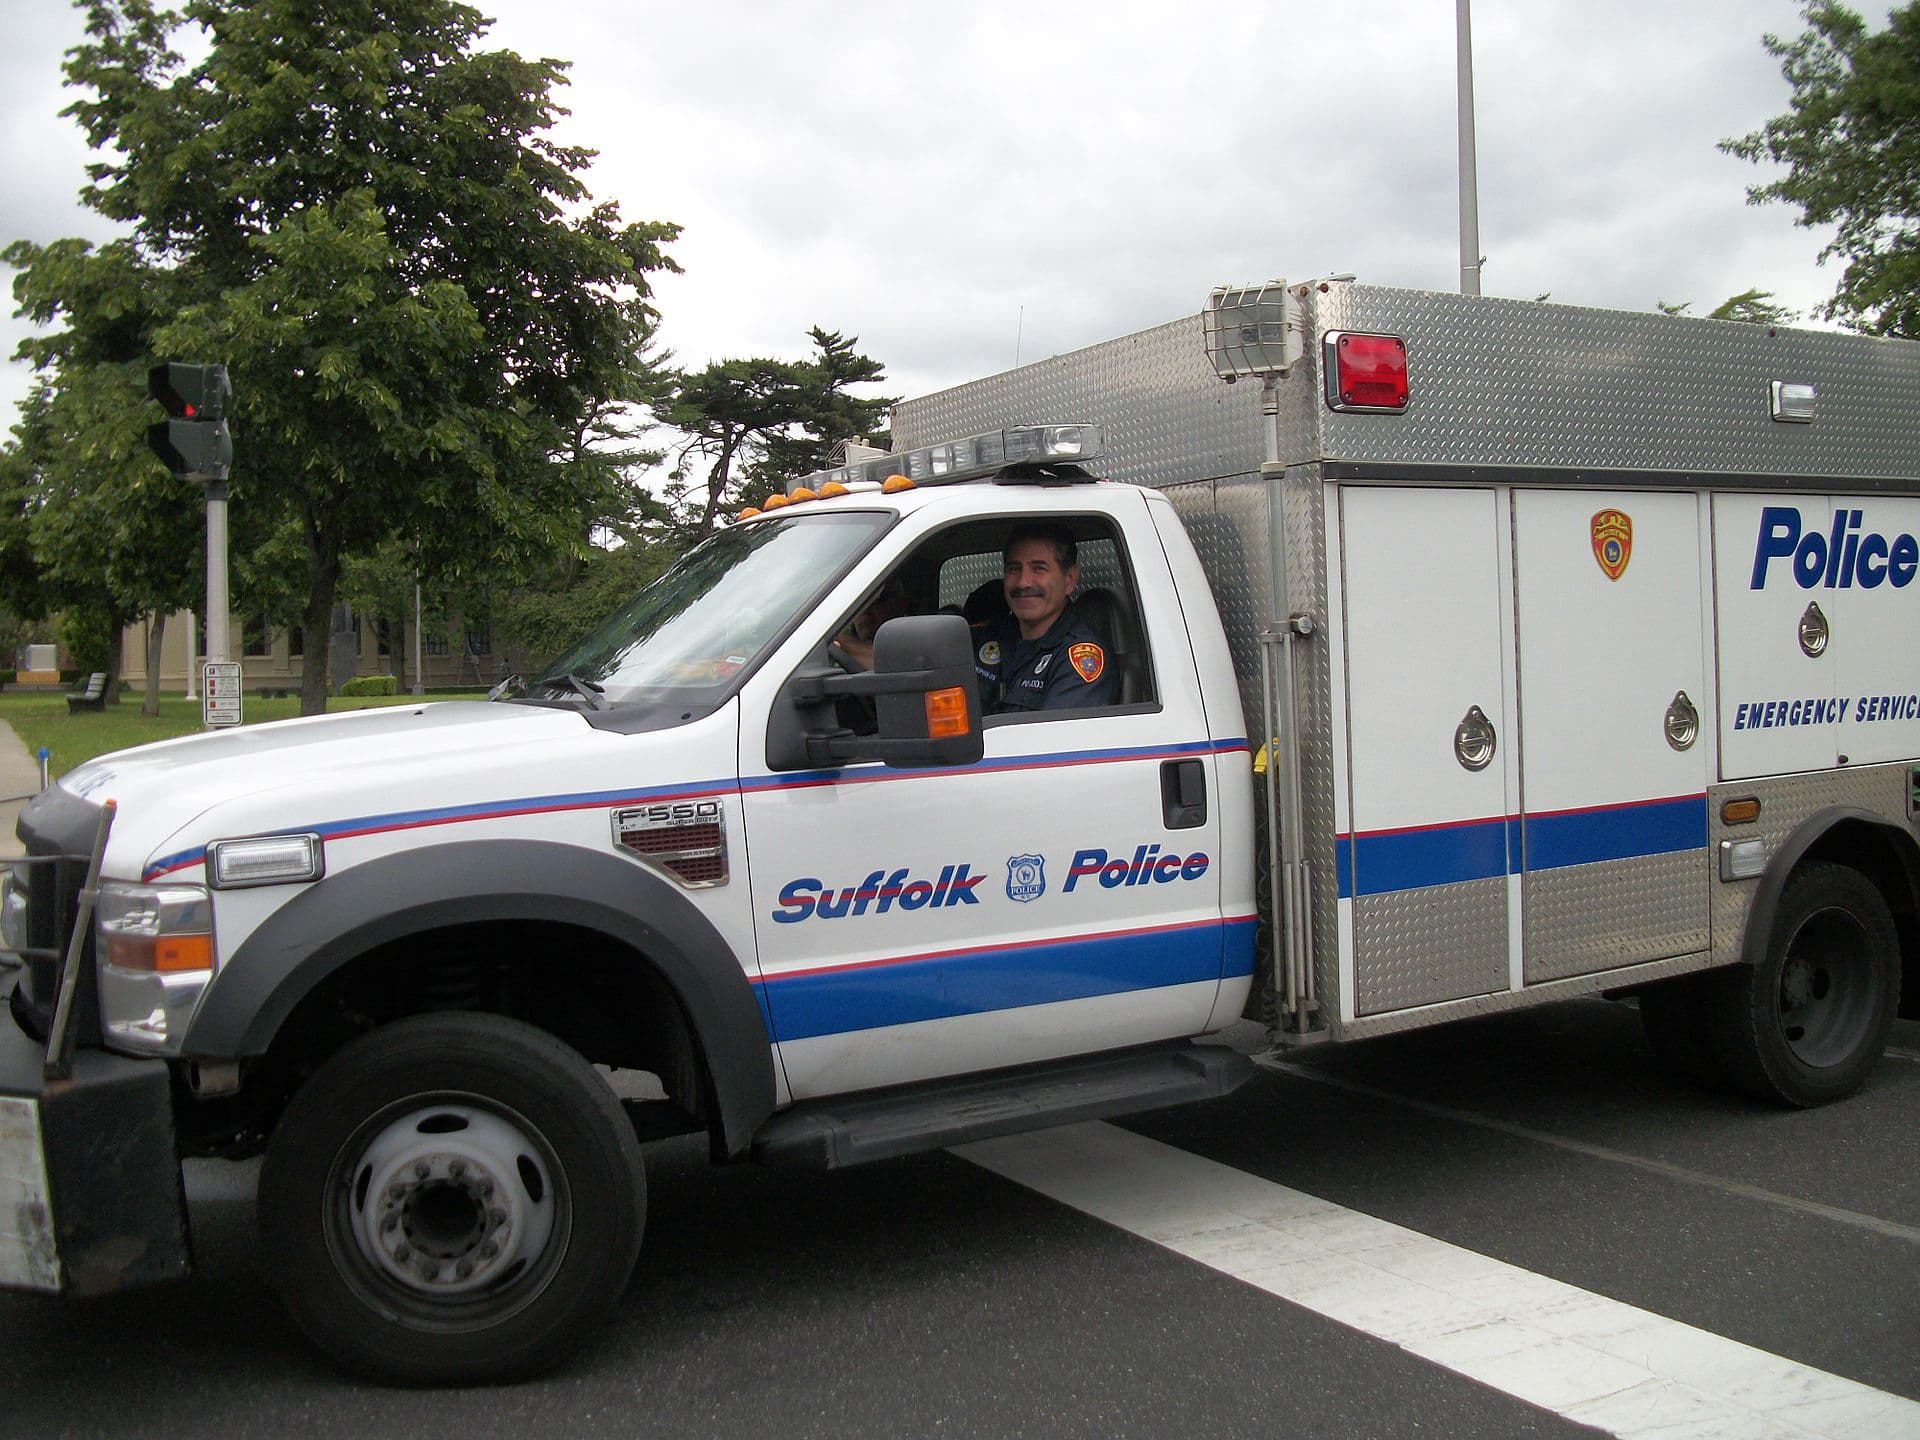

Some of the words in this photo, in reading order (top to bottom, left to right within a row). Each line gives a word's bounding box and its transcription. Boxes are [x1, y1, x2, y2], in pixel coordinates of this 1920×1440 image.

[1750, 507, 1919, 590] Police
[1734, 699, 1849, 730] EMERGENCY
[772, 864, 988, 923] Suffolk
[1062, 844, 1210, 893] Police
